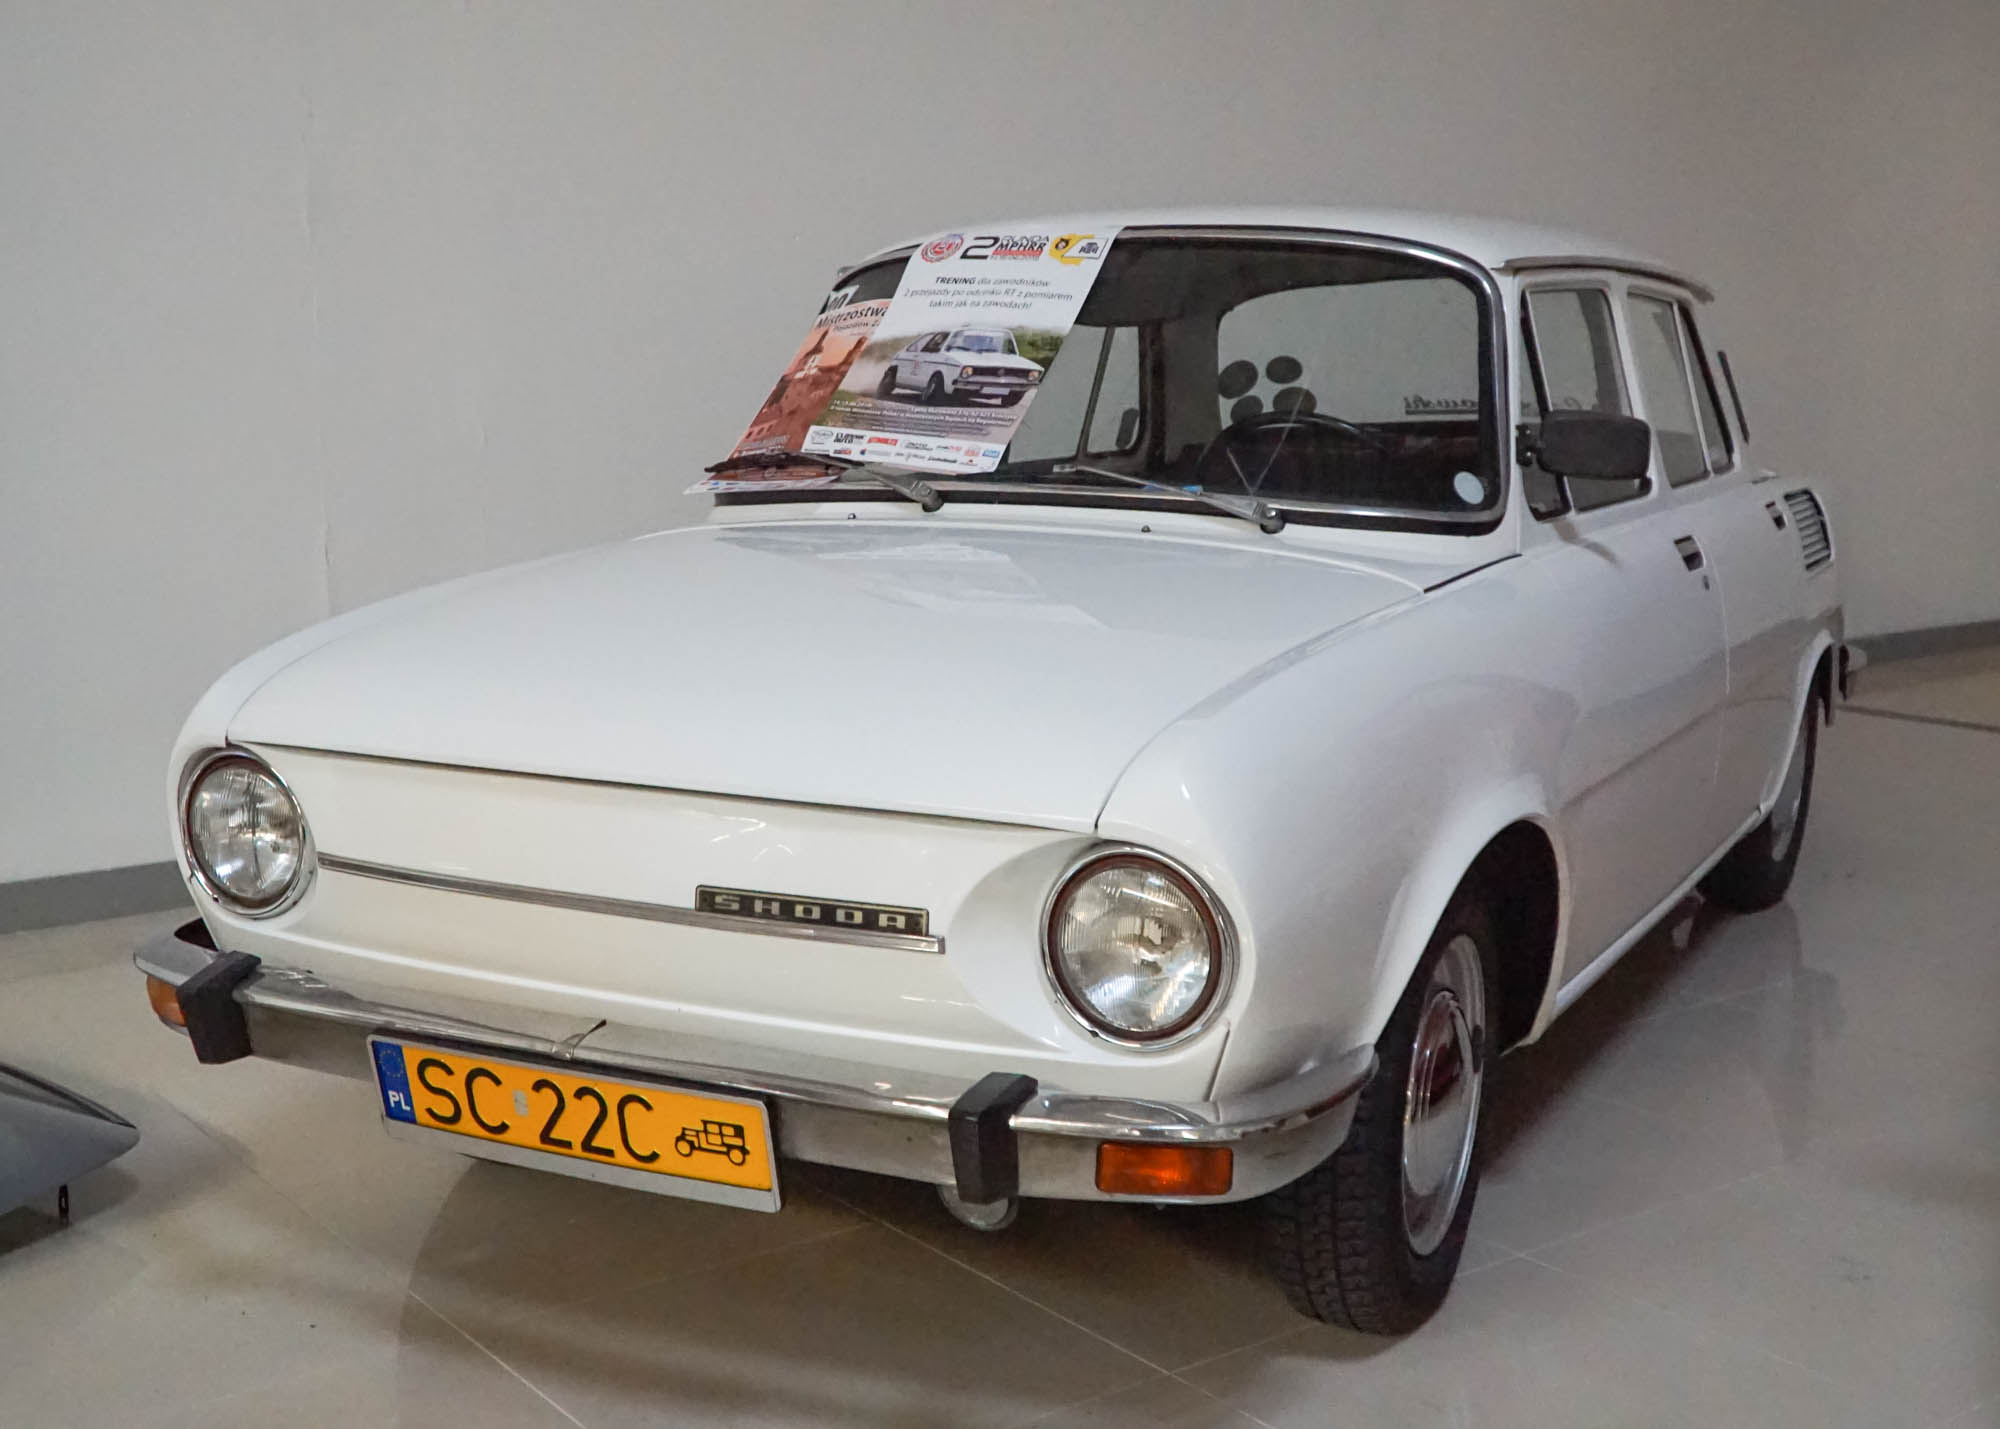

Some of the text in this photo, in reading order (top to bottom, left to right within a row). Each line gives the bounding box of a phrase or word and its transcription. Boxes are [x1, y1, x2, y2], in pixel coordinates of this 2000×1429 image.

[961, 236, 1000, 259] 2
[935, 276, 976, 286] TRENING
[388, 1089, 411, 1112] PL
[416, 1056, 660, 1164] SC 22C
